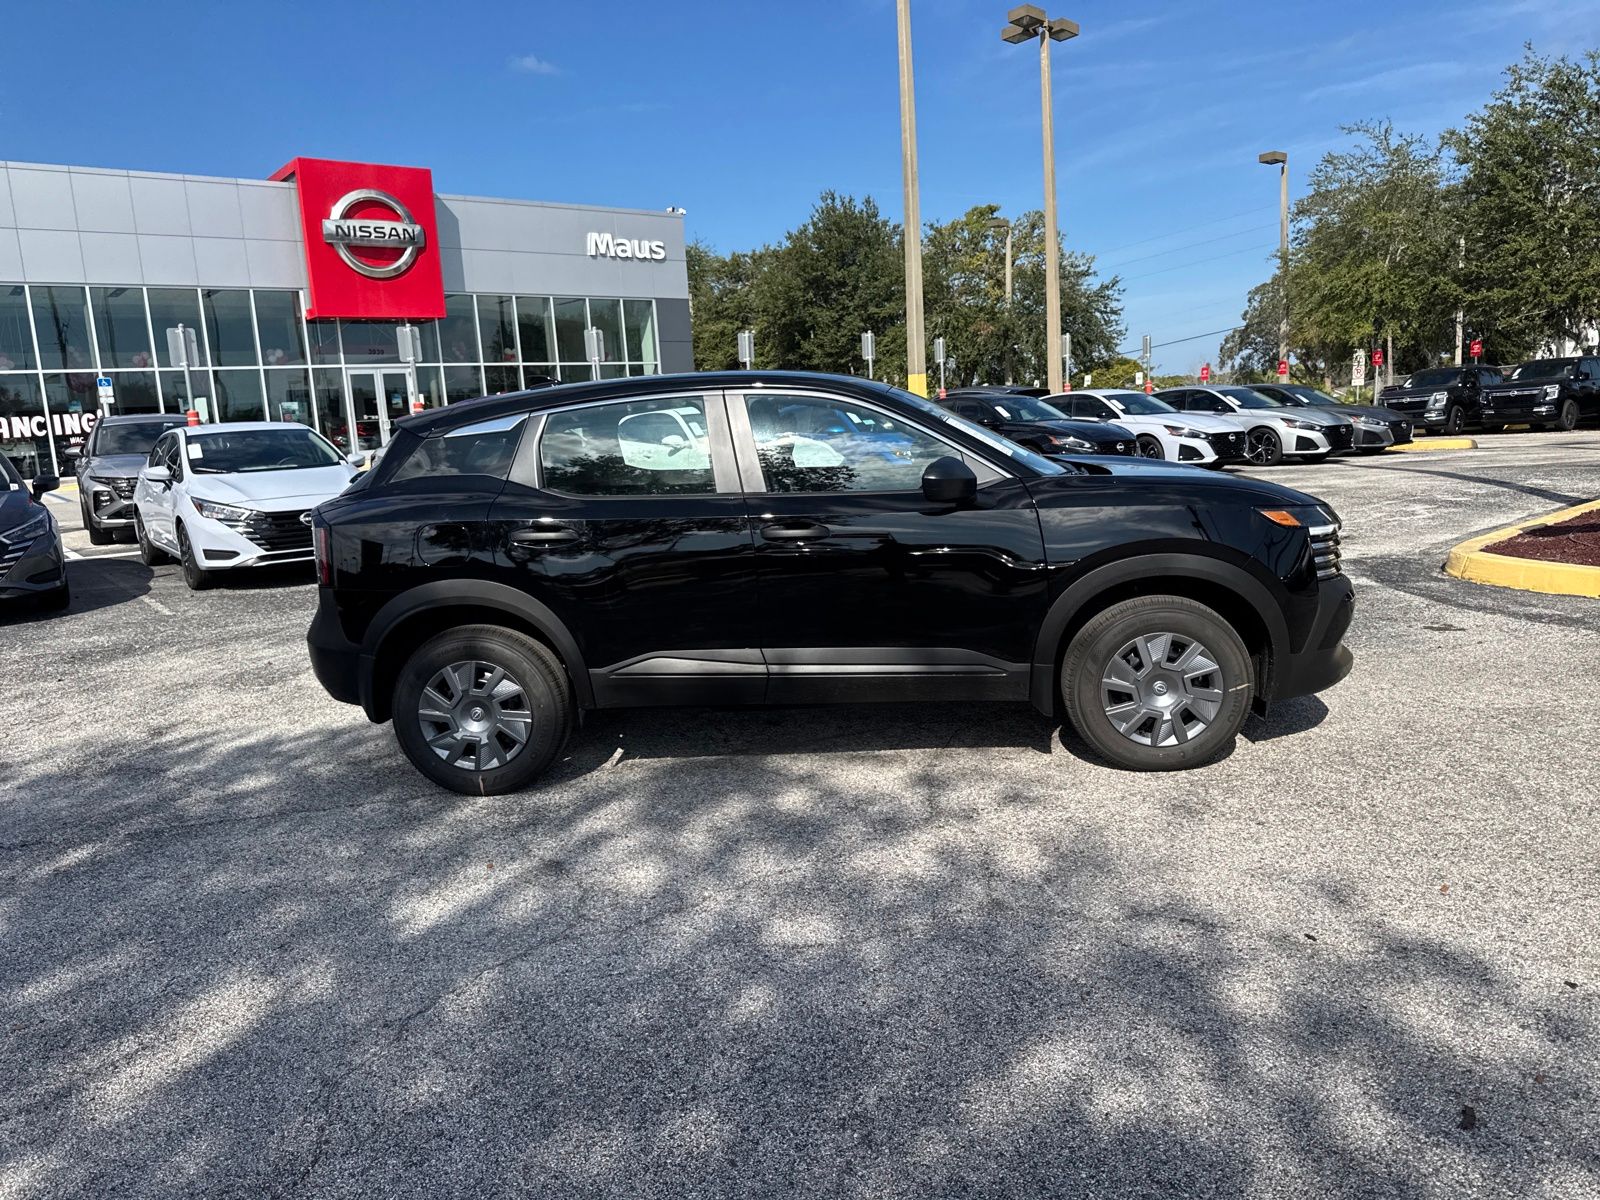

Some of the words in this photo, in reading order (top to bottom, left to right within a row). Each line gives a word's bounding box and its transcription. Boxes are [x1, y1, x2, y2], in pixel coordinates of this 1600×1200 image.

[335, 225, 416, 241] NISSAN
[587, 232, 666, 260] Maus
[69, 436, 85, 445] WAC
